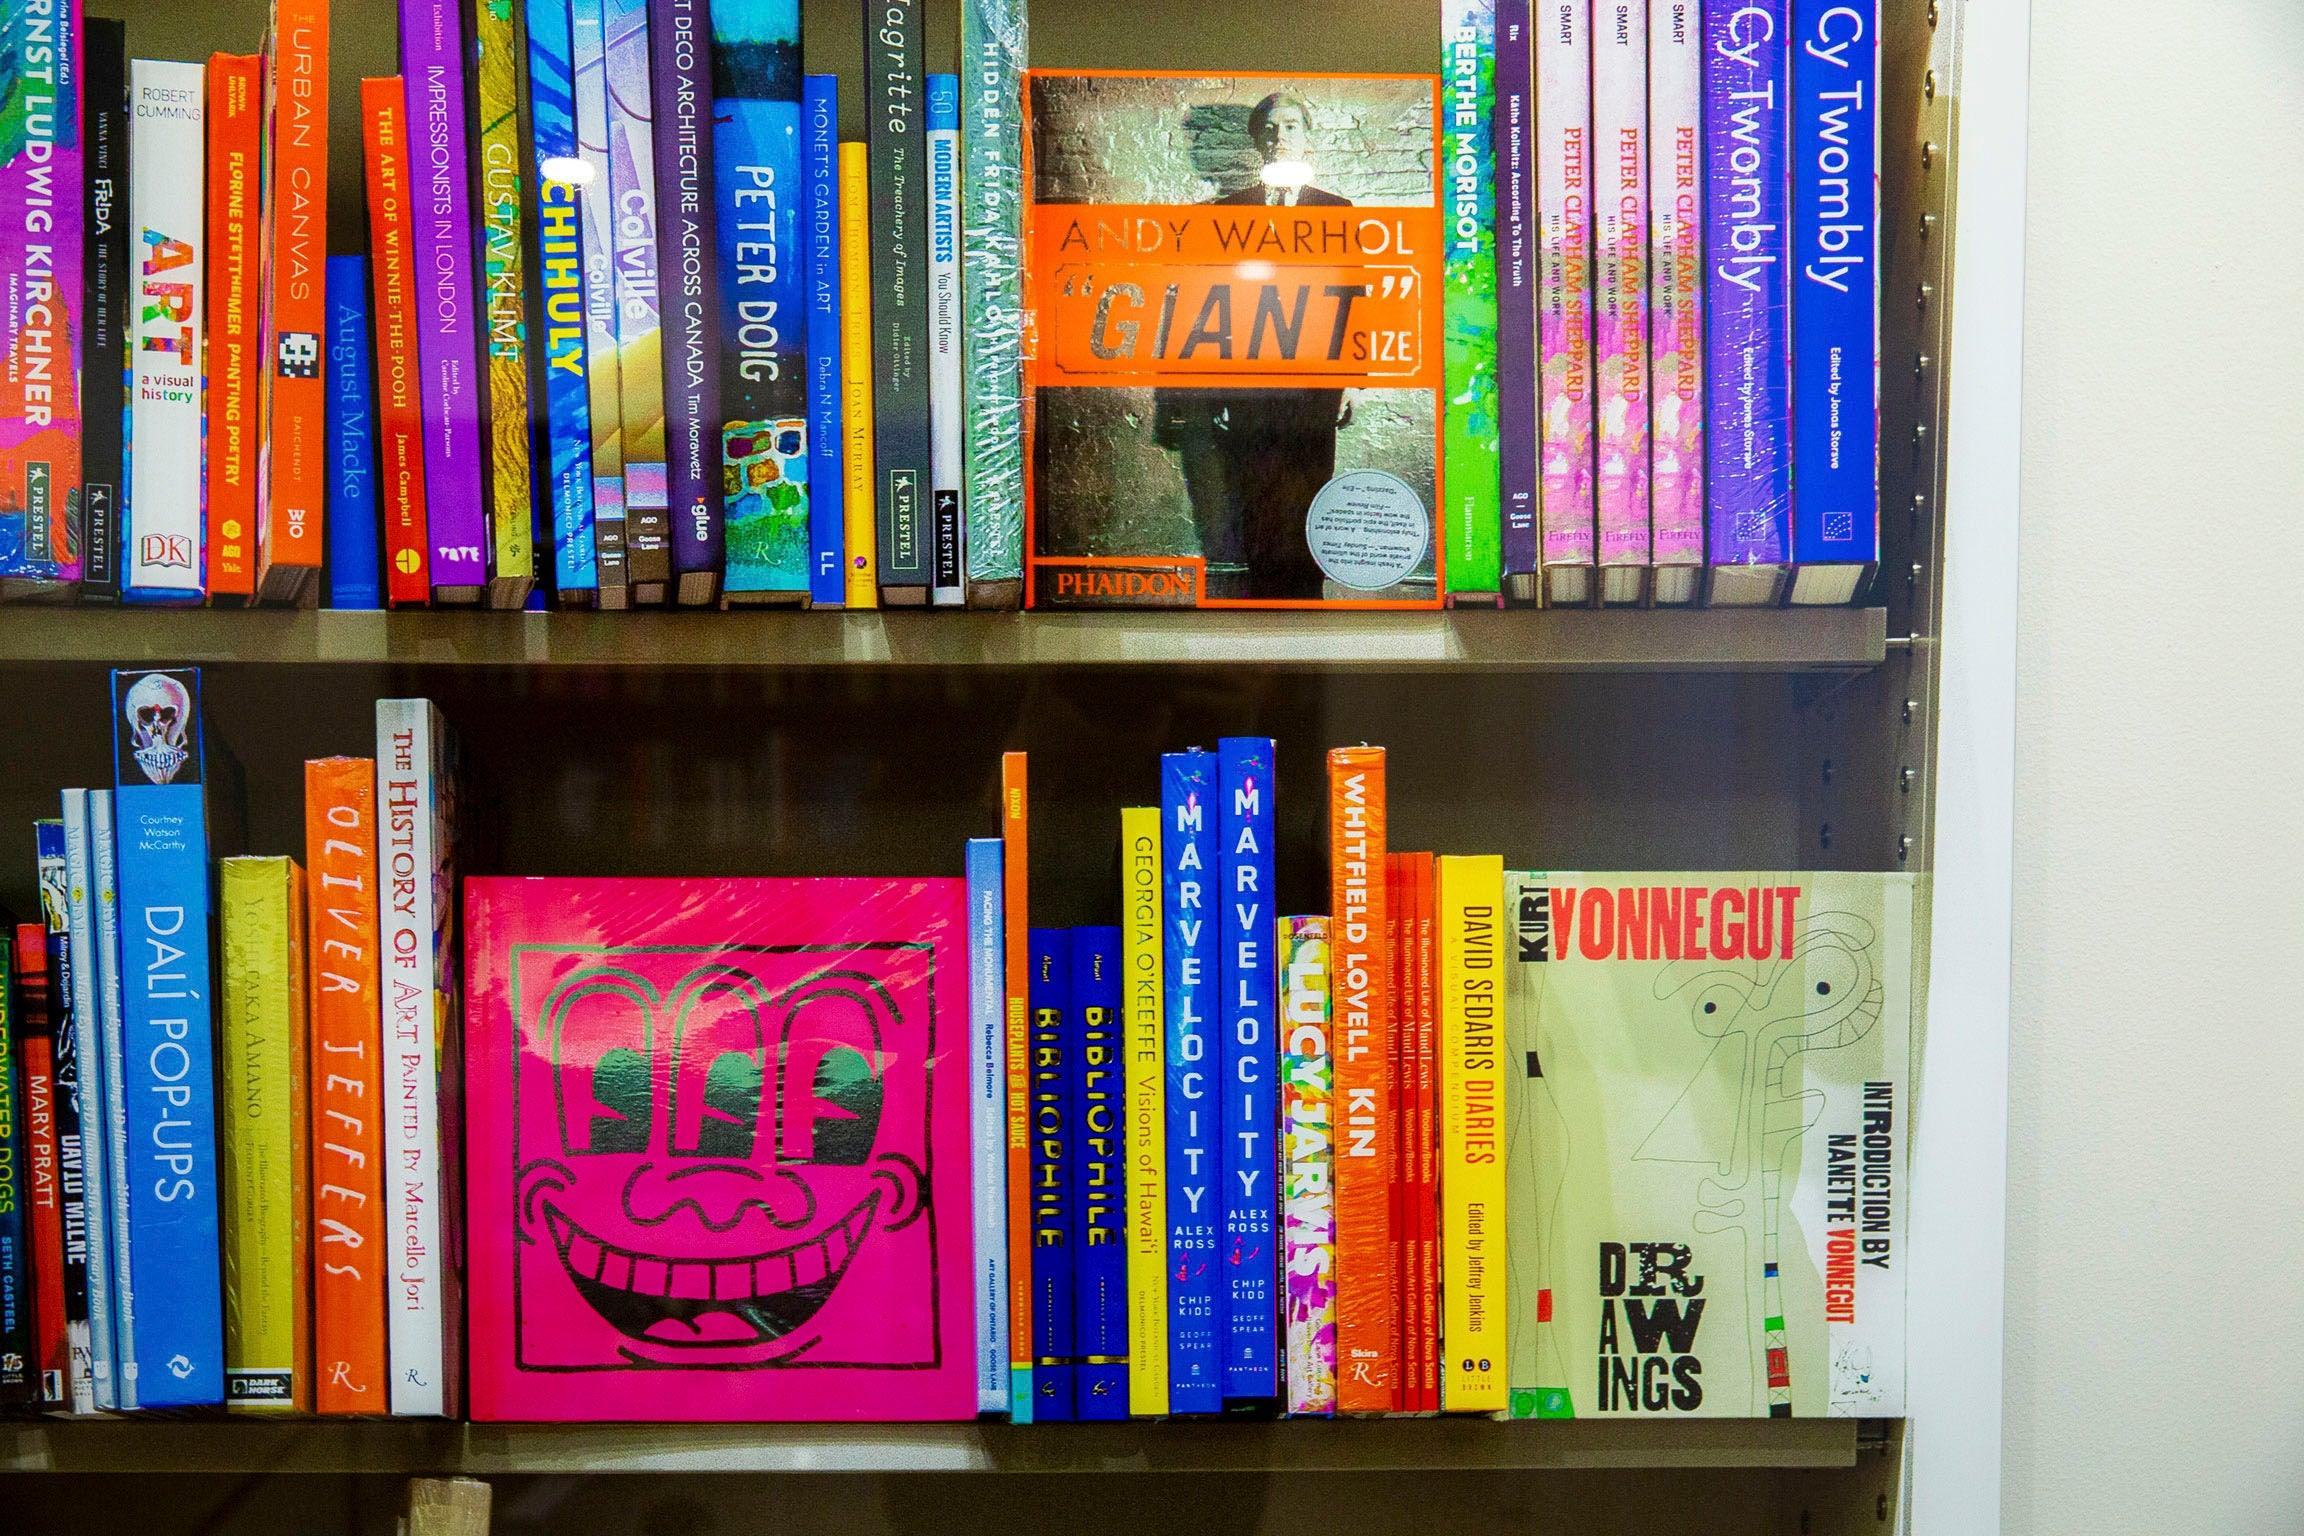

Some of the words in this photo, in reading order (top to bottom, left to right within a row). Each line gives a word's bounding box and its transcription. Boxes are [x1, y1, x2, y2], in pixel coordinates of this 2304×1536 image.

[675, 17, 694, 71] DECO
[1560, 5, 1572, 46] SMART
[1616, 5, 1628, 46] SMART
[1673, 4, 1684, 45] SMART
[1717, 7, 1774, 68] Cy
[1805, 7, 1863, 68] Cy
[143, 87, 196, 102] ROBERT
[291, 29, 312, 147] URBAN
[929, 89, 953, 116] 50
[982, 43, 1000, 137] HIDDEN
[1455, 26, 1477, 127] BERTHE
[136, 104, 201, 121] CUMMING
[378, 107, 393, 146] THE
[427, 66, 452, 215] IMPRESSIONISTS
[813, 98, 829, 178] MONET'S
[25, 96, 53, 234] LUDWIG
[380, 155, 395, 192] ART
[676, 75, 698, 214] ARCHITECTURE
[934, 138, 953, 203] MODERN
[1564, 127, 1582, 189] PETER
[1620, 128, 1637, 190] PETER
[1676, 126, 1693, 188] PETER
[228, 152, 244, 219] FLORINE
[383, 198, 397, 223] OF
[487, 144, 512, 258] GUSTAV
[892, 175, 905, 238] Treachery
[983, 150, 1000, 225] FRIDA
[1455, 134, 1478, 253] MORISOT
[1510, 172, 1521, 222] According
[1718, 80, 1777, 292] Twombly
[1805, 80, 1864, 292] Twombly
[290, 167, 311, 300] CANVAS
[435, 220, 452, 239] IN
[735, 165, 777, 285] PETER
[814, 182, 830, 258] GARDEN
[935, 204, 953, 263] ARTISTS
[1060, 218, 1191, 253] ANDY
[1212, 218, 1413, 255] WARHOL
[1564, 194, 1583, 295] CLAPHAM
[1621, 195, 1639, 295] CLAPHAM
[1677, 194, 1695, 293] CLAPHAM
[227, 224, 244, 335] STETTHEIMER
[541, 178, 583, 377] CHIHULY
[620, 190, 656, 320] Colville
[681, 219, 701, 296] ACROSS
[985, 234, 1002, 325] KAHLO
[8, 273, 18, 333] IMAGINARY
[143, 226, 194, 365] ART
[435, 245, 456, 334] LONDON
[491, 272, 518, 362] KLIMT
[815, 281, 831, 314] ART
[8, 338, 18, 383] TRAVELS
[25, 245, 52, 426] KIRCHNER
[332, 306, 363, 395] August
[684, 303, 704, 389] CANADA
[738, 301, 779, 382] DOIG
[1352, 330, 1413, 362] SIZE
[1566, 300, 1584, 402] SHEPPARD
[1622, 300, 1640, 403] SHEPPARD
[1678, 299, 1695, 401] SHEPPARD
[1830, 347, 1841, 376] Edited
[141, 388, 193, 404] history
[154, 375, 194, 387] visual
[226, 343, 241, 421] PAINTING
[688, 394, 700, 416] Tim
[818, 357, 832, 391] Debra
[820, 411, 833, 458] Mancoff
[1830, 396, 1842, 427] Jonas
[225, 423, 240, 486] POETRY
[341, 410, 367, 499] Macke
[394, 433, 409, 465] James
[688, 421, 701, 480] Morawetz
[32, 487, 44, 550] PRESTEL
[397, 469, 412, 527] Campbell
[691, 504, 708, 542] glue
[899, 495, 911, 559] PRESTEL
[93, 509, 104, 572] PRESTEL
[144, 536, 185, 563] DK
[820, 551, 834, 576] LL
[941, 515, 954, 579] PRESTEL
[1548, 529, 1590, 542] FIREFLY
[1605, 530, 1647, 542] FIREFLY
[1659, 529, 1700, 541] FIREFLY
[1057, 572, 1191, 595] PHAIDON
[393, 728, 413, 771] THE
[140, 815, 182, 826] Courtney
[1010, 788, 1021, 820] NIXON
[139, 840, 186, 851] McCarthy
[389, 780, 418, 918] HISTORY
[1344, 773, 1368, 944] WHITFIELD
[322, 806, 364, 993] OLIVER
[1135, 837, 1154, 945] GEORGIA
[145, 906, 200, 1000] DALÍ
[393, 928, 417, 968] OF
[1464, 906, 1493, 969] DAVID
[1518, 885, 1549, 963] KURT
[1549, 886, 1800, 961] VONNEGUT
[393, 978, 423, 1044] ART
[1136, 953, 1156, 1063] O'KEEFFE
[1177, 806, 1206, 1214] MARVELOCITY
[1234, 789, 1260, 1197] MARVELOCITY
[1345, 954, 1368, 1062] LOVELL
[1464, 979, 1494, 1070] SEDARIS
[1009, 997, 1024, 1071] HOUSEPLANTS
[1288, 963, 1327, 1092] LUCY
[247, 1032, 266, 1119] AMANO
[402, 1054, 420, 1140] PAINTED
[1010, 1093, 1025, 1112] HOT
[30, 1075, 50, 1143] MARY
[149, 1019, 195, 1202] POP-UPS
[1011, 1116, 1025, 1149] SAUCE
[1138, 1077, 1157, 1147] Visions
[1347, 1088, 1376, 1157] KIN
[1464, 1080, 1496, 1165] DIARIES
[34, 1145, 53, 1209] PRATT
[320, 1041, 366, 1281] JEFFERS
[402, 1149, 421, 1172] BY
[1138, 1154, 1157, 1176] of
[1827, 1134, 1857, 1223] NANETTE
[1862, 1081, 1893, 1231] INTRODUCTION
[1229, 1210, 1268, 1220] ALEX
[1290, 1100, 1330, 1276] JARVIS
[1468, 1203, 1484, 1236] Edited
[1, 1237, 12, 1272] SETH
[404, 1182, 425, 1269] Marcello
[1174, 1226, 1213, 1236] ALEX
[1174, 1239, 1215, 1249] ROSS
[1227, 1222, 1269, 1233] ROSS
[1466, 1240, 1483, 1253] by
[1862, 1238, 1890, 1269] BY
[400, 1274, 425, 1312] Jori
[1466, 1255, 1484, 1289] Jeffrey
[1599, 1242, 1704, 1297] DR
[1825, 1228, 1856, 1325] VONNEGUT
[3, 1277, 15, 1334] CASTEEL
[1467, 1291, 1482, 1333] Jenkins
[1599, 1298, 1706, 1354] AW
[247, 1385, 285, 1395] HORSE
[249, 1378, 279, 1387] DARK
[1599, 1356, 1703, 1412] INGS
